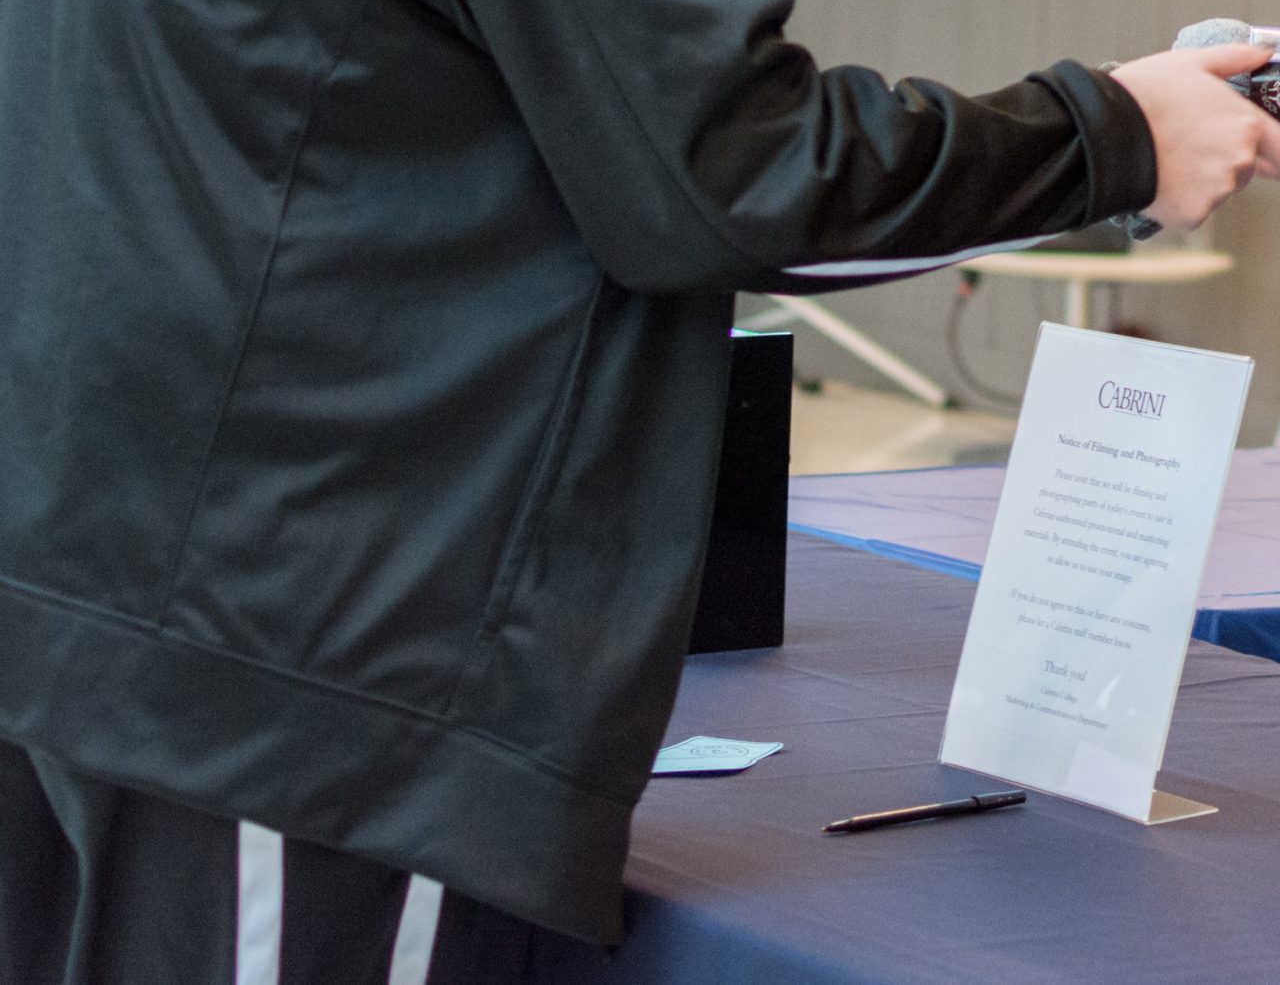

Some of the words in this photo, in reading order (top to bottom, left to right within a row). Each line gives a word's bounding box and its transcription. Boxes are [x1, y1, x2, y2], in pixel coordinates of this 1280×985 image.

[1098, 380, 1167, 418] CABRINI
[1057, 433, 1081, 448] Notice
[1082, 439, 1092, 450] of
[1091, 440, 1119, 459] Filming
[1120, 449, 1135, 459] and
[1134, 449, 1181, 471] Photography
[1055, 468, 1073, 481] Please
[1112, 481, 1123, 492] will
[1124, 483, 1132, 493] be
[1133, 485, 1153, 501] filming
[1155, 492, 1168, 502] and
[1038, 488, 1081, 507] photographing
[1081, 498, 1098, 509] parts
[1128, 509, 1146, 519] event
[1087, 521, 1127, 537] promotional
[1126, 530, 1138, 540] and
[1139, 534, 1169, 549] marketing
[1055, 556, 1071, 567] allow
[1098, 568, 1113, 579] your
[1061, 538, 1088, 552] attending
[1090, 542, 1099, 552] the
[1132, 555, 1143, 563] are
[1143, 558, 1169, 572] agreeing
[1050, 600, 1066, 612] agree
[1094, 609, 1110, 621] have
[1110, 616, 1121, 627] any
[1017, 614, 1037, 625] please
[1051, 620, 1072, 634] Cabrini
[1073, 628, 1088, 638] staff
[1088, 633, 1113, 645] member
[1044, 660, 1067, 676] Thank
[1067, 669, 1088, 682] you!
